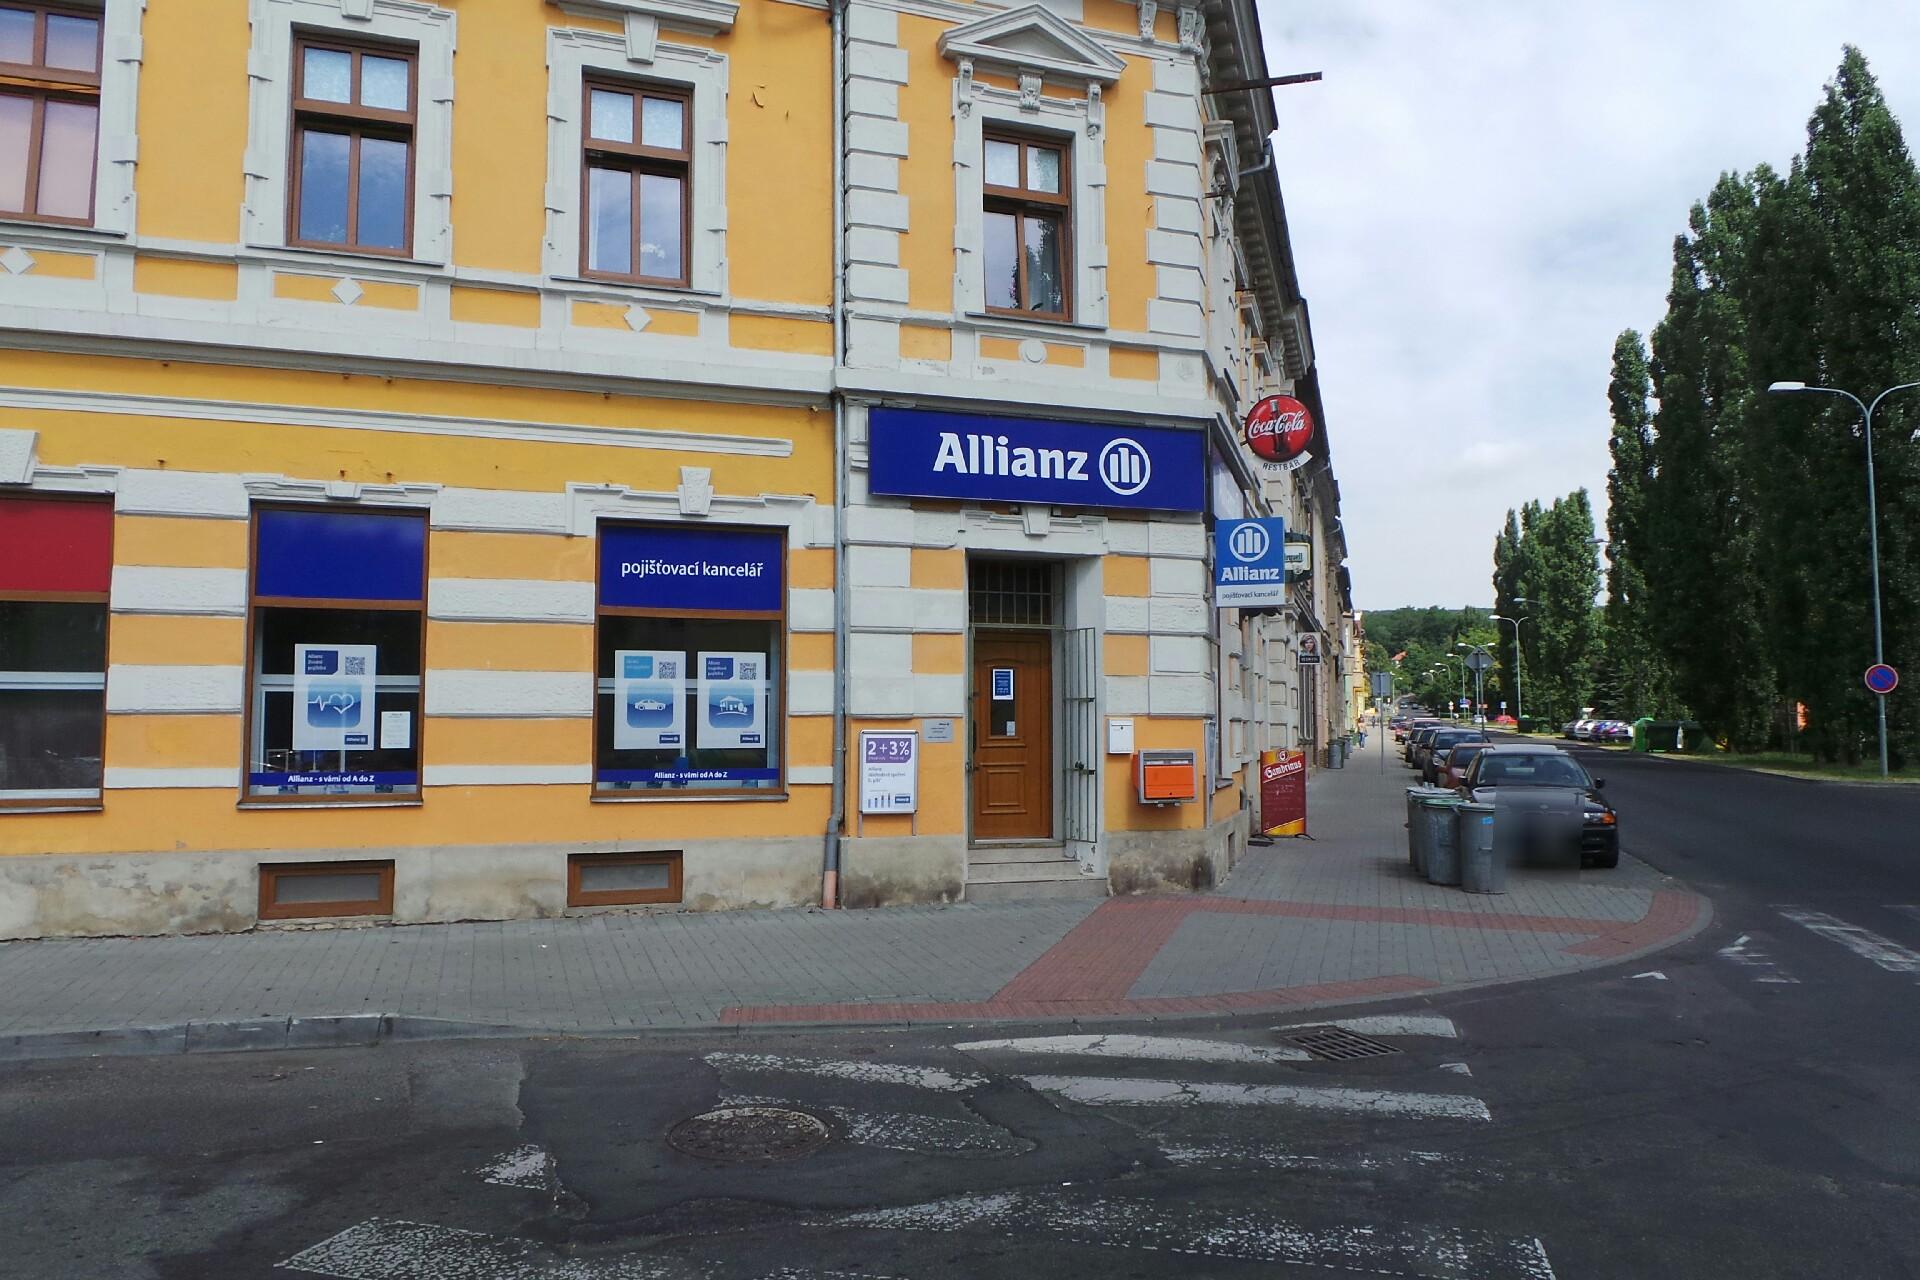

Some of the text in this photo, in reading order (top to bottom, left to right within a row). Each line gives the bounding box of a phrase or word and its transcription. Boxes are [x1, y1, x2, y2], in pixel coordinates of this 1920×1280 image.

[933, 432, 1089, 481] Allianz
[1262, 460, 1301, 472] RESTBAR
[621, 559, 764, 578] pojišťovací kancelář
[1221, 566, 1280, 582] Allianz
[1254, 589, 1279, 598] kancelář
[1264, 760, 1302, 779] Gambrinus
[288, 775, 313, 783] Allianz
[324, 775, 341, 783] vámi
[342, 775, 352, 783] od
